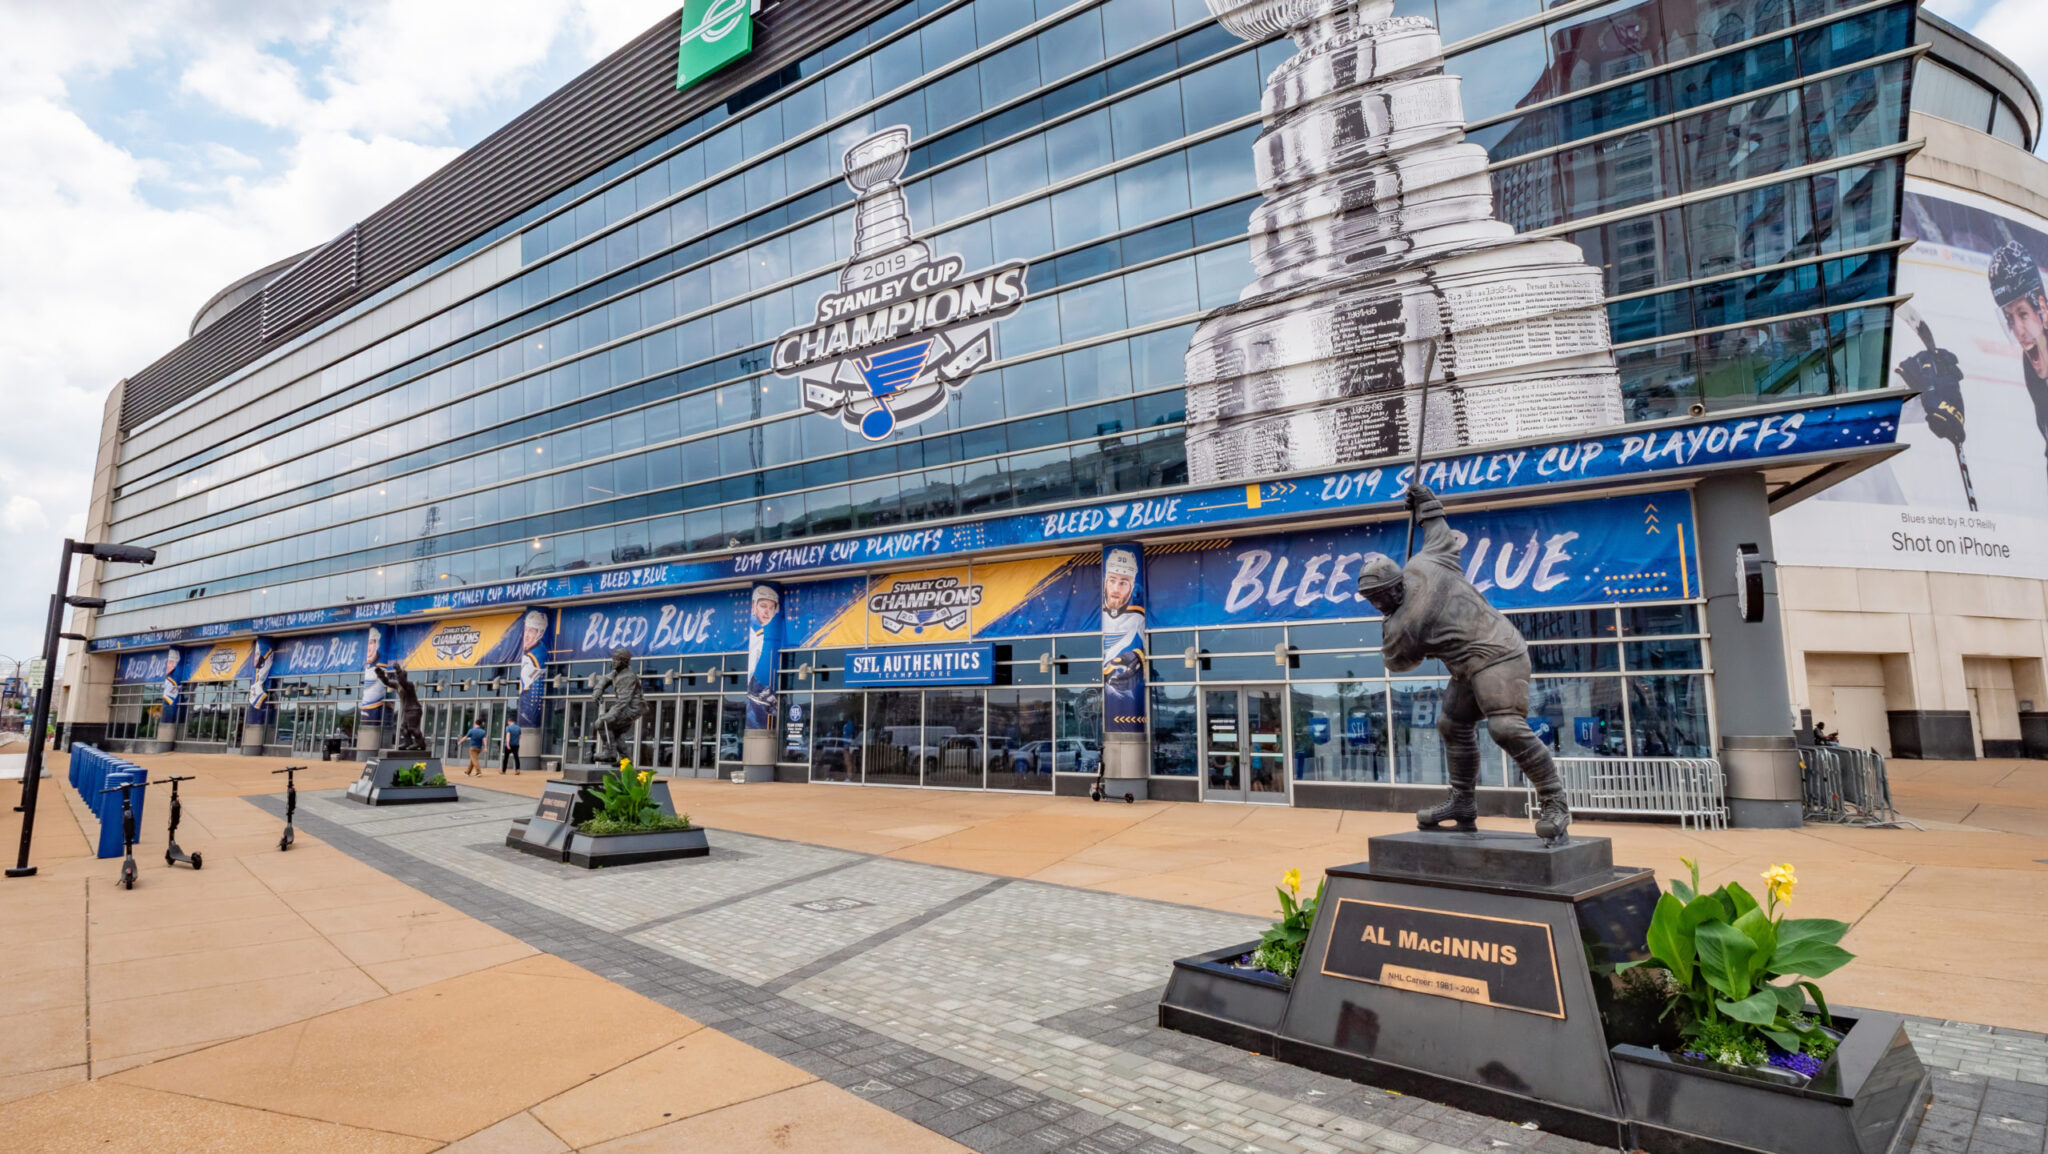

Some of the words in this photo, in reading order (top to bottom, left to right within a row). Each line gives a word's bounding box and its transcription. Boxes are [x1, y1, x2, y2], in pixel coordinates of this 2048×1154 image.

[863, 254, 906, 280] 2019
[820, 277, 908, 322] STANLEY
[910, 262, 959, 292] CUP
[778, 271, 1021, 369] CHAMPIONS
[1320, 468, 1383, 501] 2019
[1390, 451, 1526, 498] STANLEY
[1537, 441, 1603, 476] CUP
[1618, 413, 1805, 466] PLAYOFFS
[1044, 509, 1104, 537] BLEED
[1126, 497, 1182, 529] BLUE
[1901, 512, 1926, 524] Blues
[1928, 515, 1946, 526] shot
[1948, 516, 1957, 528] by
[734, 551, 763, 573] 2019
[766, 544, 827, 573] STANLEY
[830, 540, 860, 562] CUP
[865, 528, 944, 558] PLAYOFFS
[1892, 532, 1932, 552] Shot
[1936, 540, 1956, 553] on
[1960, 537, 2010, 558] iPhone
[600, 571, 630, 589] BLEED
[641, 565, 669, 585] BLUE
[893, 581, 935, 593] STANLEY
[935, 578, 957, 589] CUP
[1224, 549, 1380, 613] BLEE
[452, 588, 484, 608] STANLEY
[487, 588, 503, 602] CUP
[506, 580, 548, 600] PLAYOFFS
[870, 587, 982, 611] CHAMPIONS
[355, 605, 374, 618] BLEED
[380, 601, 396, 614] BLUE
[432, 632, 480, 646] CHAMPIONS
[582, 612, 648, 652] BLEED
[649, 604, 716, 651] BLUE
[289, 641, 324, 670] BLEED
[324, 637, 358, 669] BLUE
[853, 656, 880, 673] STL
[883, 651, 980, 672] AUTHENTICS
[125, 657, 147, 680] BLEED
[1361, 924, 1391, 946] AL
[1398, 930, 1518, 966] MacINNIS
[1388, 972, 1404, 982] NHL
[1406, 975, 1433, 986] Career:
[1461, 985, 1480, 995] 2004
